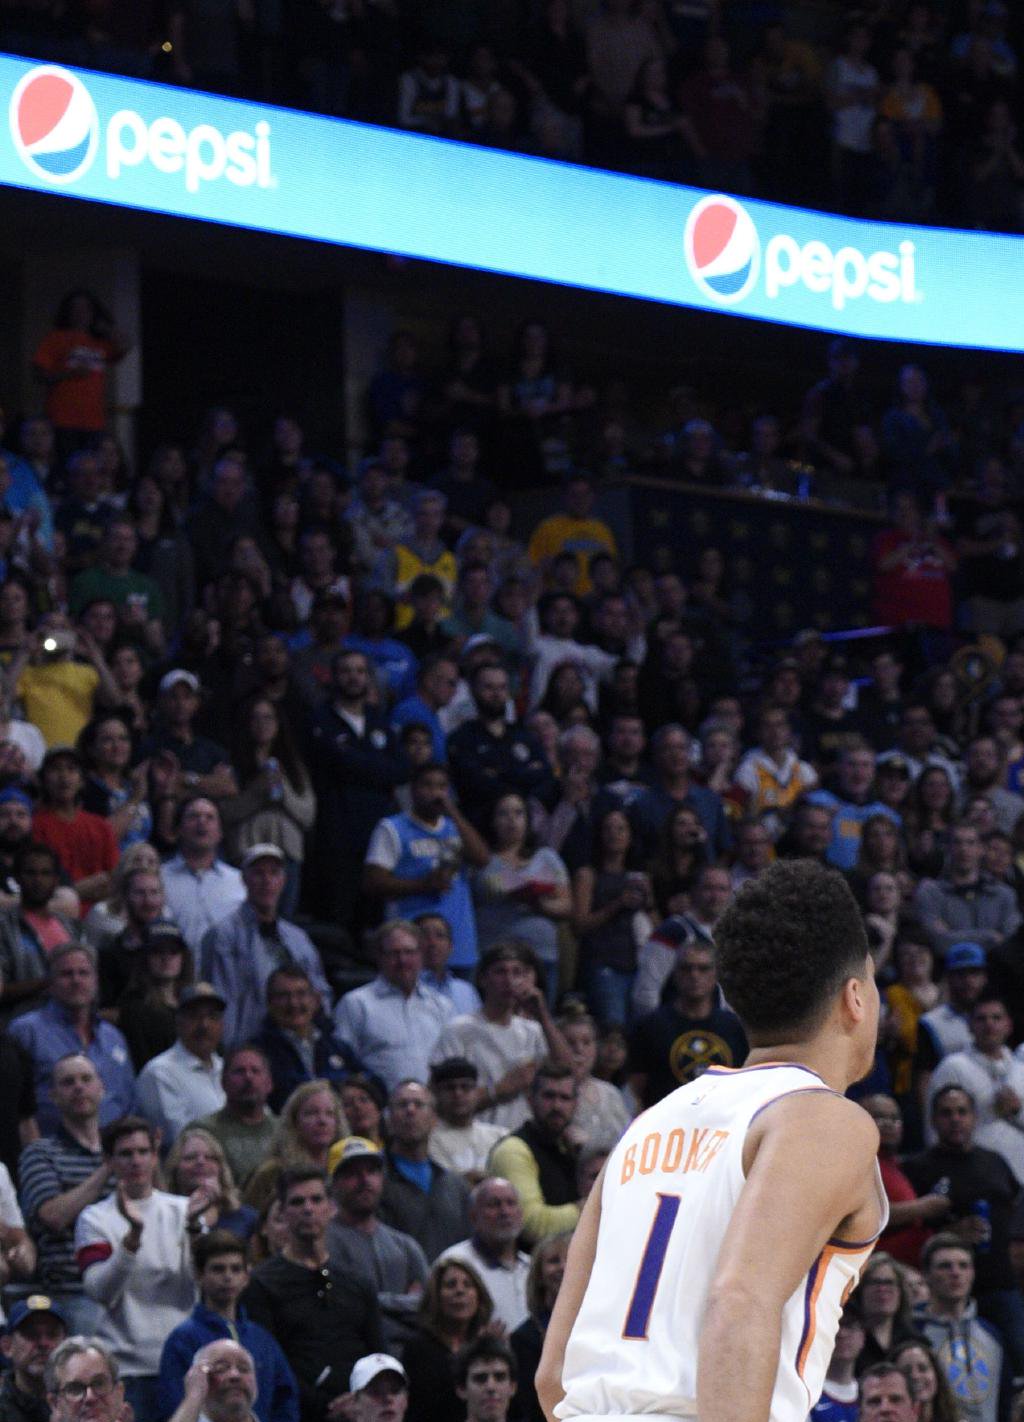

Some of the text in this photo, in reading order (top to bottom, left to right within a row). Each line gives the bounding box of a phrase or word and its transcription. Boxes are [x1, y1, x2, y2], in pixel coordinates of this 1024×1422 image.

[106, 109, 272, 193] pepsi
[765, 233, 916, 311] pepsi
[621, 1191, 682, 1341] 1
